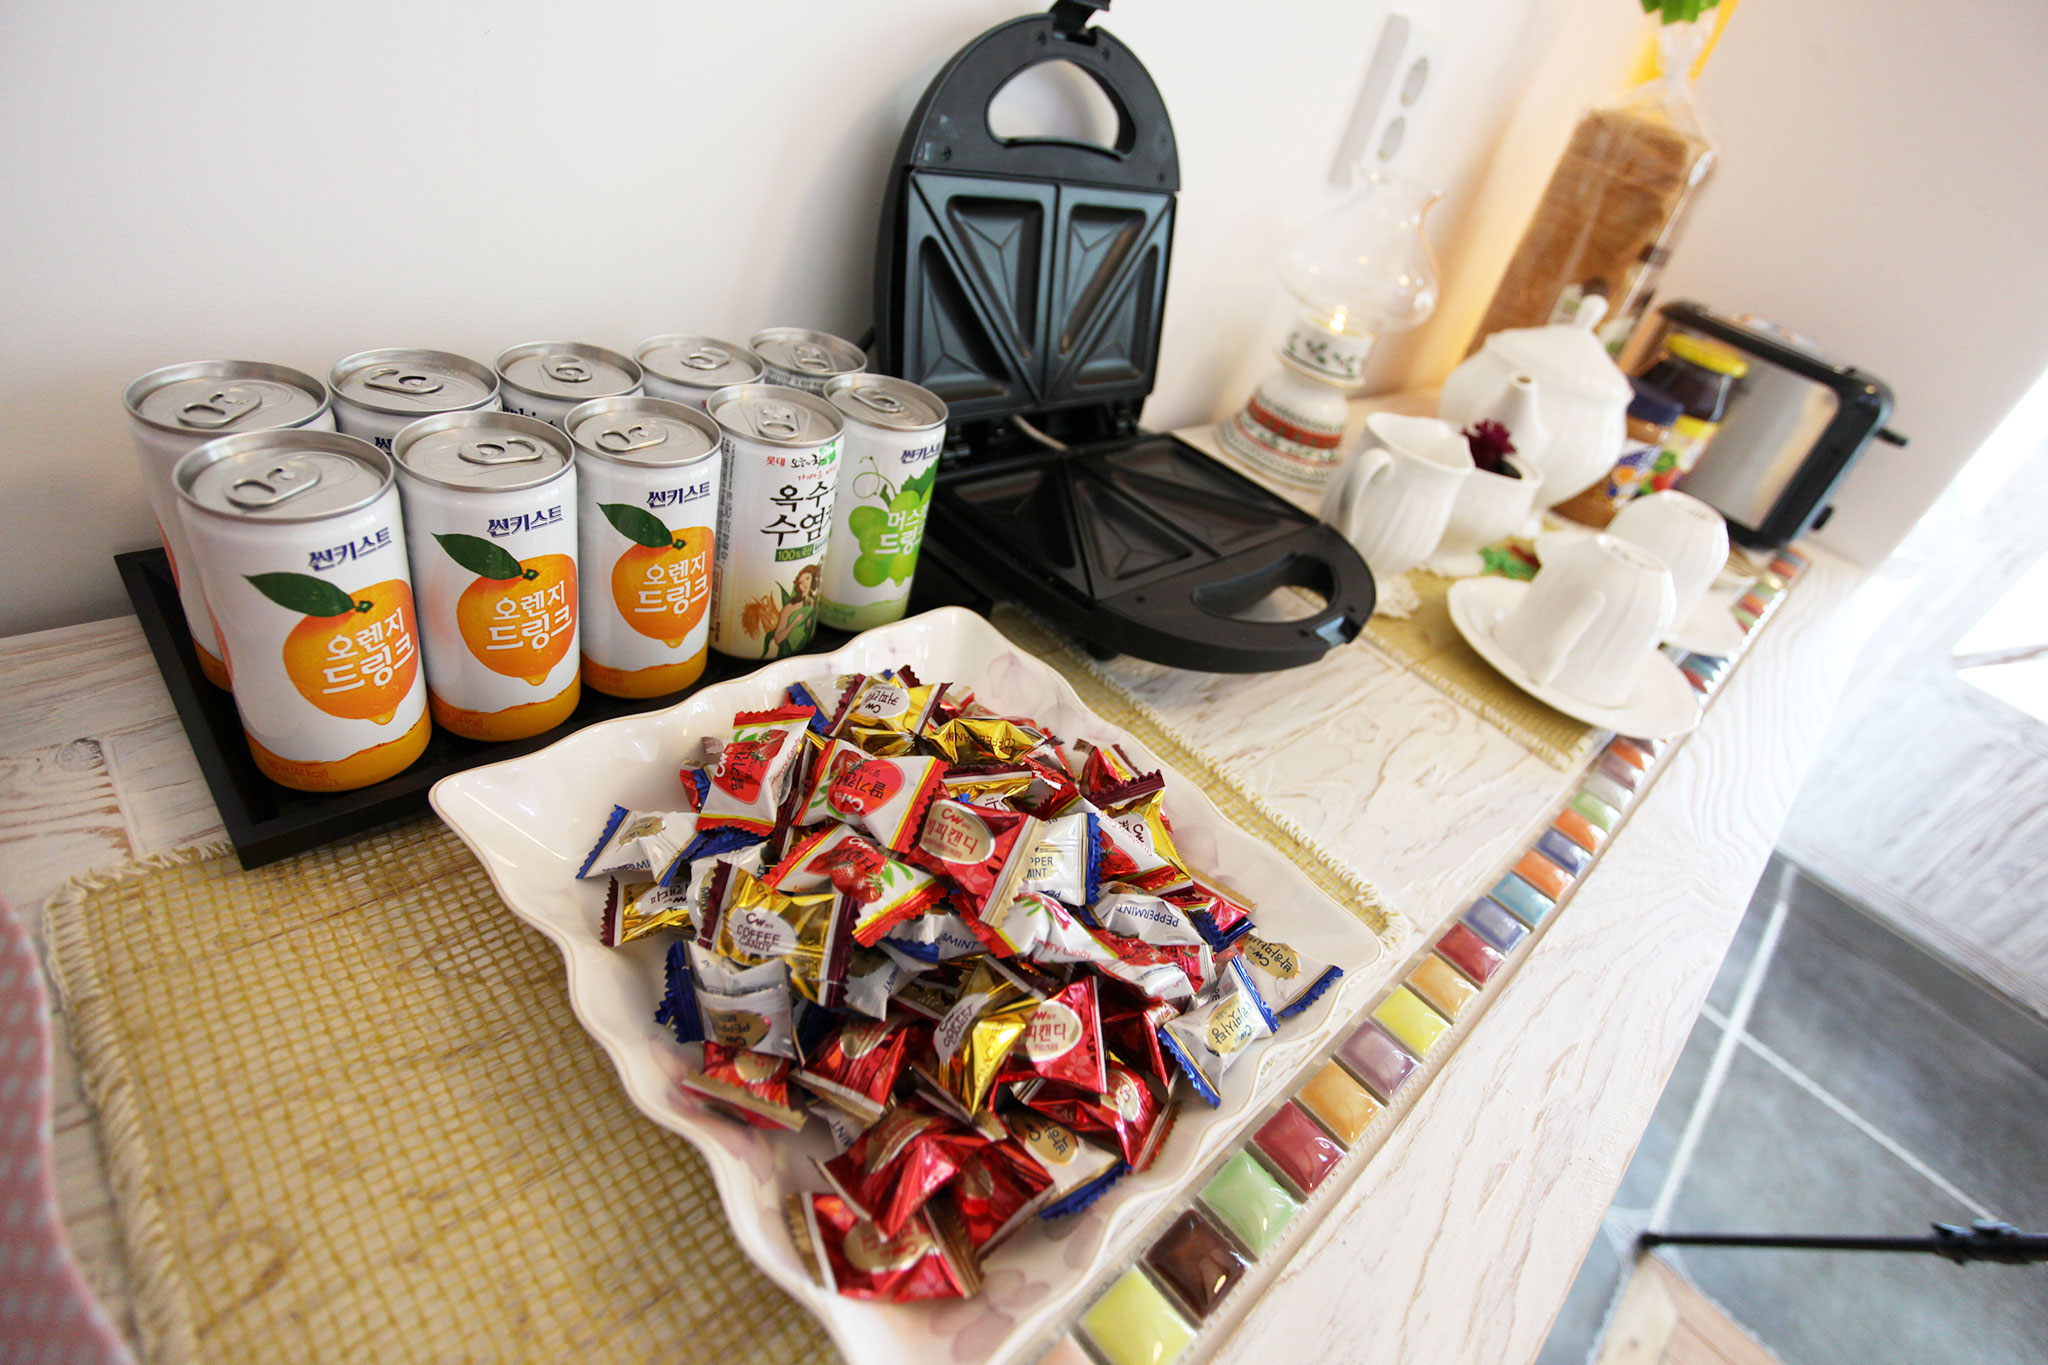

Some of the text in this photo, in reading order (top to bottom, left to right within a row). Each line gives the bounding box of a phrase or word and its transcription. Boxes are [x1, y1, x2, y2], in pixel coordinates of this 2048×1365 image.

[766, 455, 786, 467] 롯데
[646, 481, 711, 509] 썬키스트
[487, 505, 563, 538] 썬키스트
[308, 527, 393, 572] 썬키스트
[643, 550, 706, 585] 오렌지
[493, 580, 565, 620] 오렌지
[634, 574, 709, 615] 드링크
[326, 607, 405, 661] 오렌지
[486, 604, 573, 650] 드링크
[322, 632, 415, 694] 드링크
[1114, 903, 1180, 927] PEPPERMINT
[736, 924, 781, 945] COFFEE
[738, 936, 771, 951] CANDY
[1023, 1023, 1065, 1042] 피캔디
